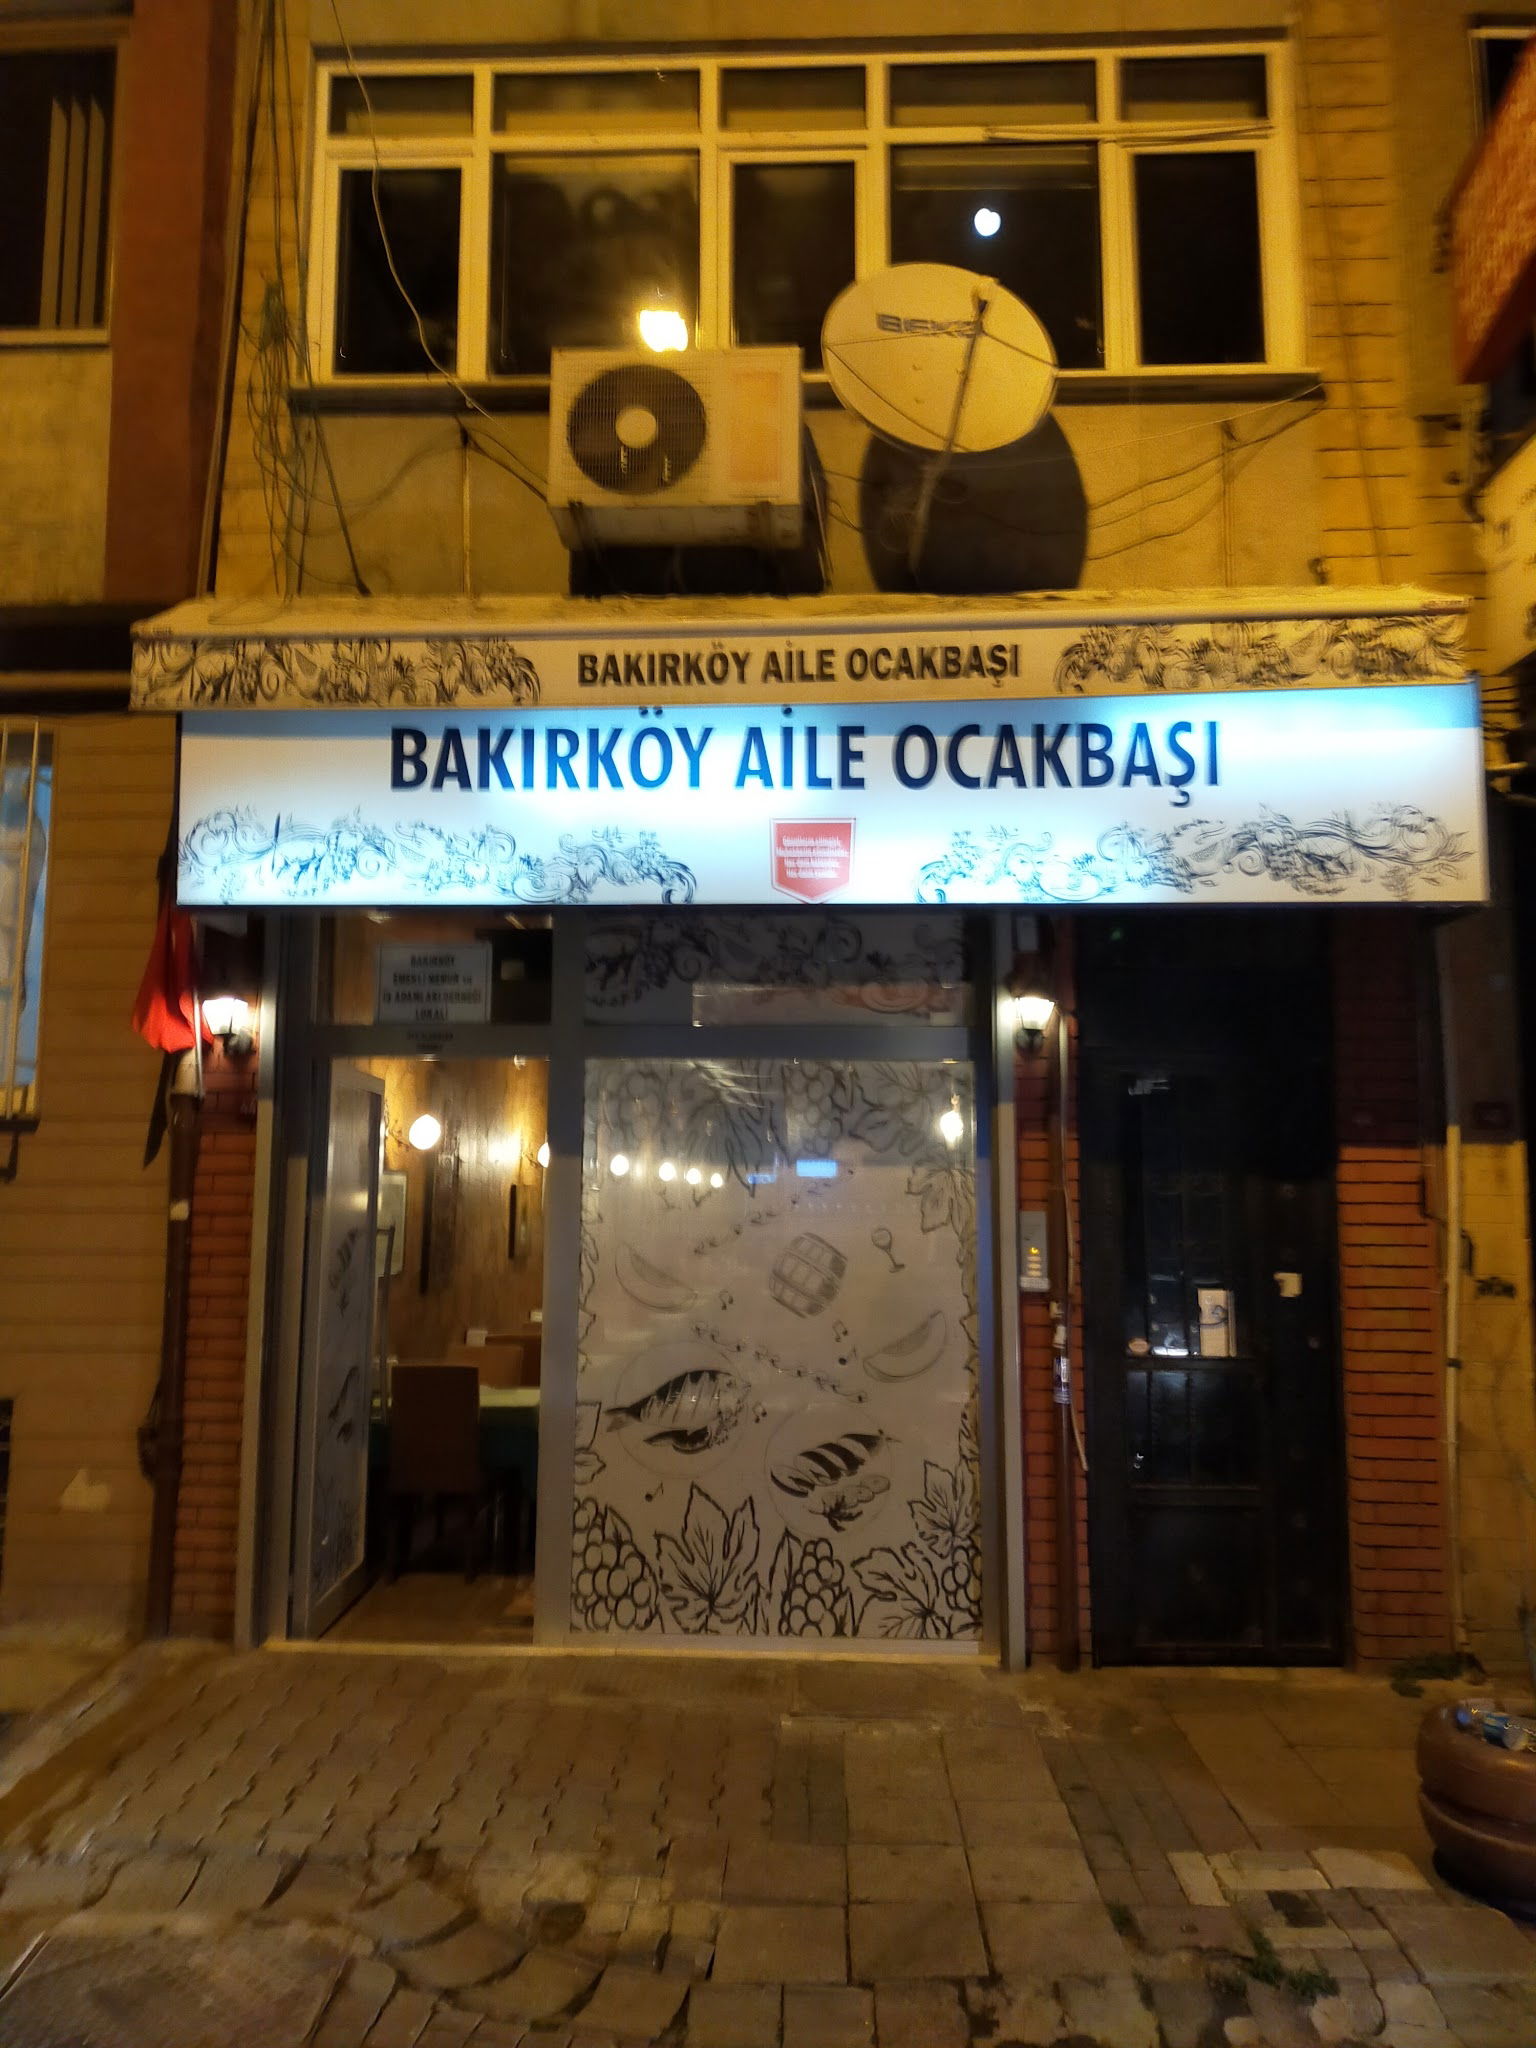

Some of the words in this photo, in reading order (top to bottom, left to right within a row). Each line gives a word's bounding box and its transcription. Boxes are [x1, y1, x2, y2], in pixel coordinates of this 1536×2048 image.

[578, 641, 749, 688] BAKIRKÖY
[761, 639, 835, 683] AİLE
[846, 644, 1020, 687] OCAKBAŞI
[390, 705, 713, 792] BAKIRKÖY
[734, 704, 866, 791] AİLE
[893, 721, 1220, 807] OCAKBAŞI
